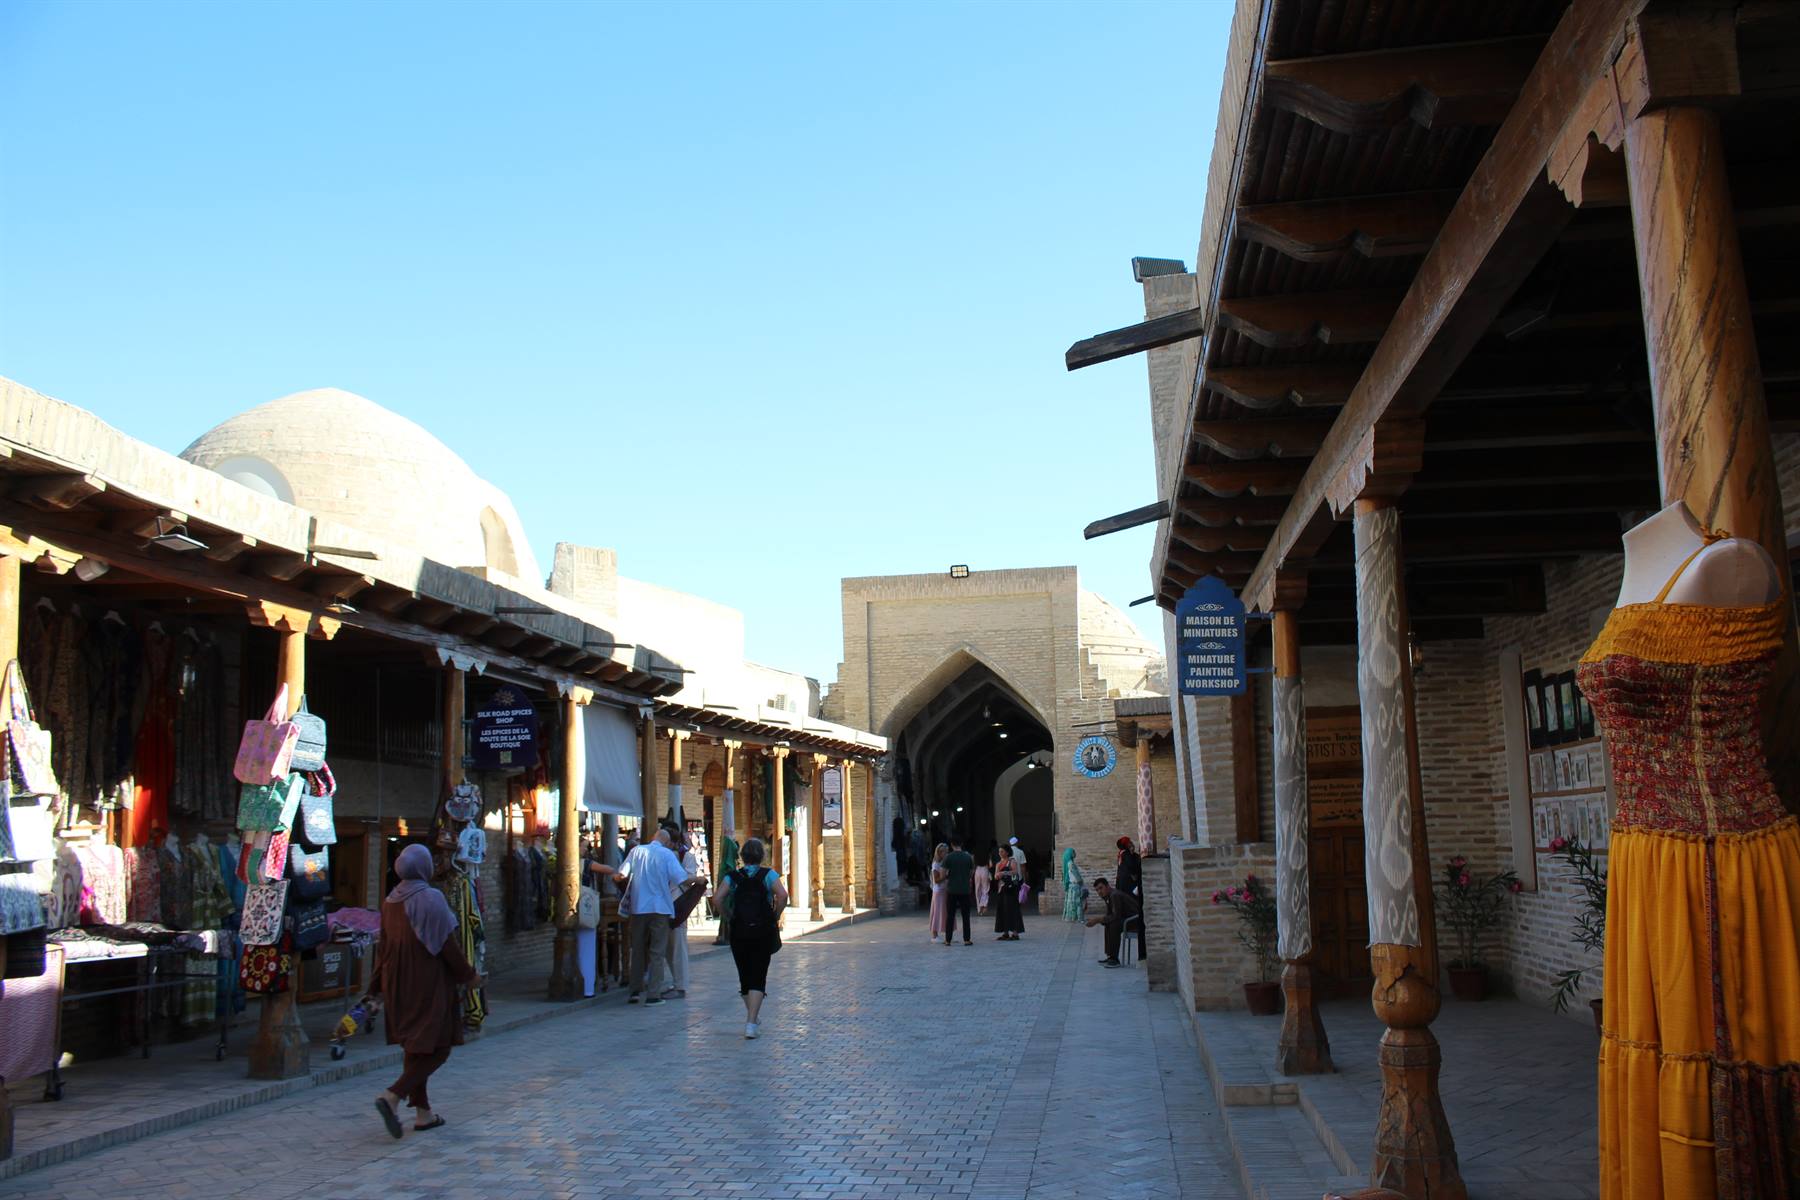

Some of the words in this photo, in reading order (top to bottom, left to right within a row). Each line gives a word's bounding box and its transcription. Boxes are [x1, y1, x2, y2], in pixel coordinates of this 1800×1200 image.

[1186, 616, 1221, 625] MAISON
[1223, 616, 1235, 625] DE
[1183, 628, 1238, 637] MINIATURES
[1187, 655, 1236, 664] MINATURE
[1190, 667, 1234, 676] PAINTING
[1185, 679, 1240, 688] WORKSHOP
[1307, 743, 1346, 757] RTIST'S
